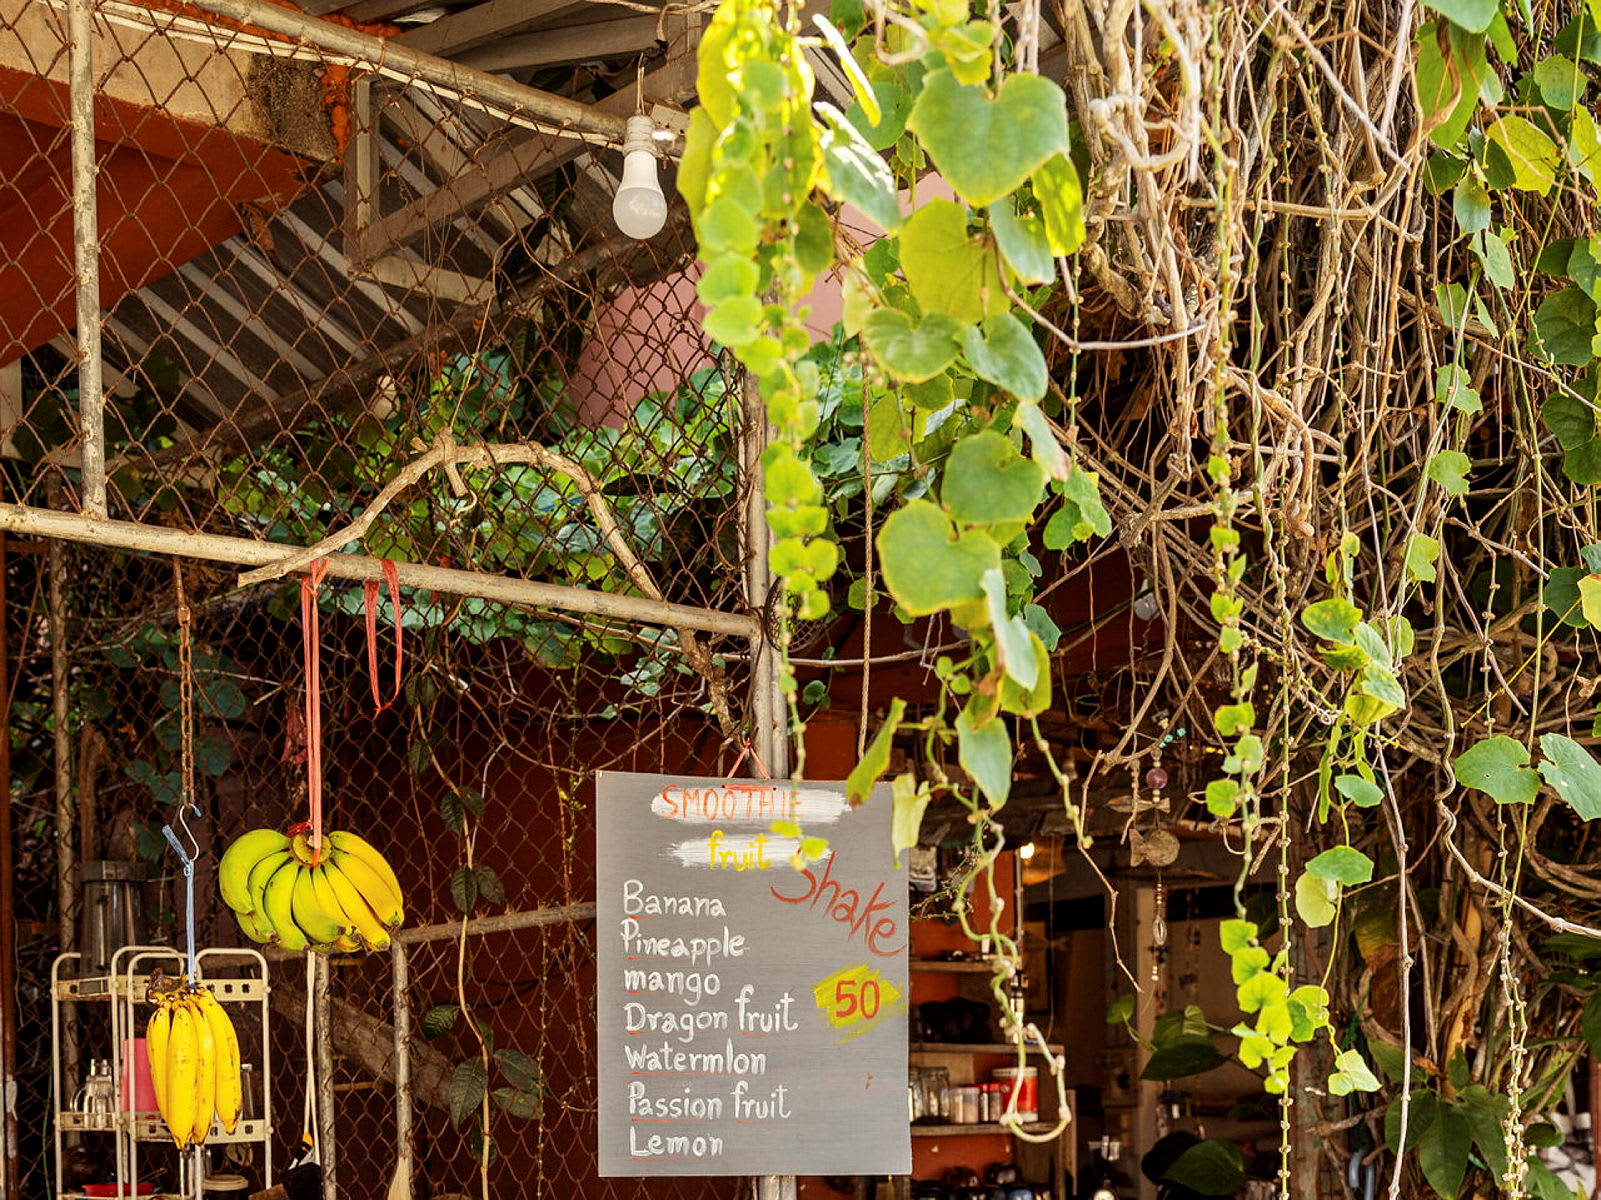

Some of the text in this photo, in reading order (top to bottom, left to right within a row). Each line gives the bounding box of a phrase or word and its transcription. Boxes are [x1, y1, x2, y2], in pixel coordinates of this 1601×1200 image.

[661, 784, 805, 820] SMOOTHIE
[707, 830, 772, 871] fruit
[623, 879, 727, 917] Banana
[620, 918, 746, 967] Pineapple
[624, 969, 721, 1006] mango
[834, 980, 881, 1020] 50
[623, 984, 800, 1042] Dragon fruit
[628, 1080, 793, 1119] Passion fruit
[630, 1126, 724, 1157] Lemon
